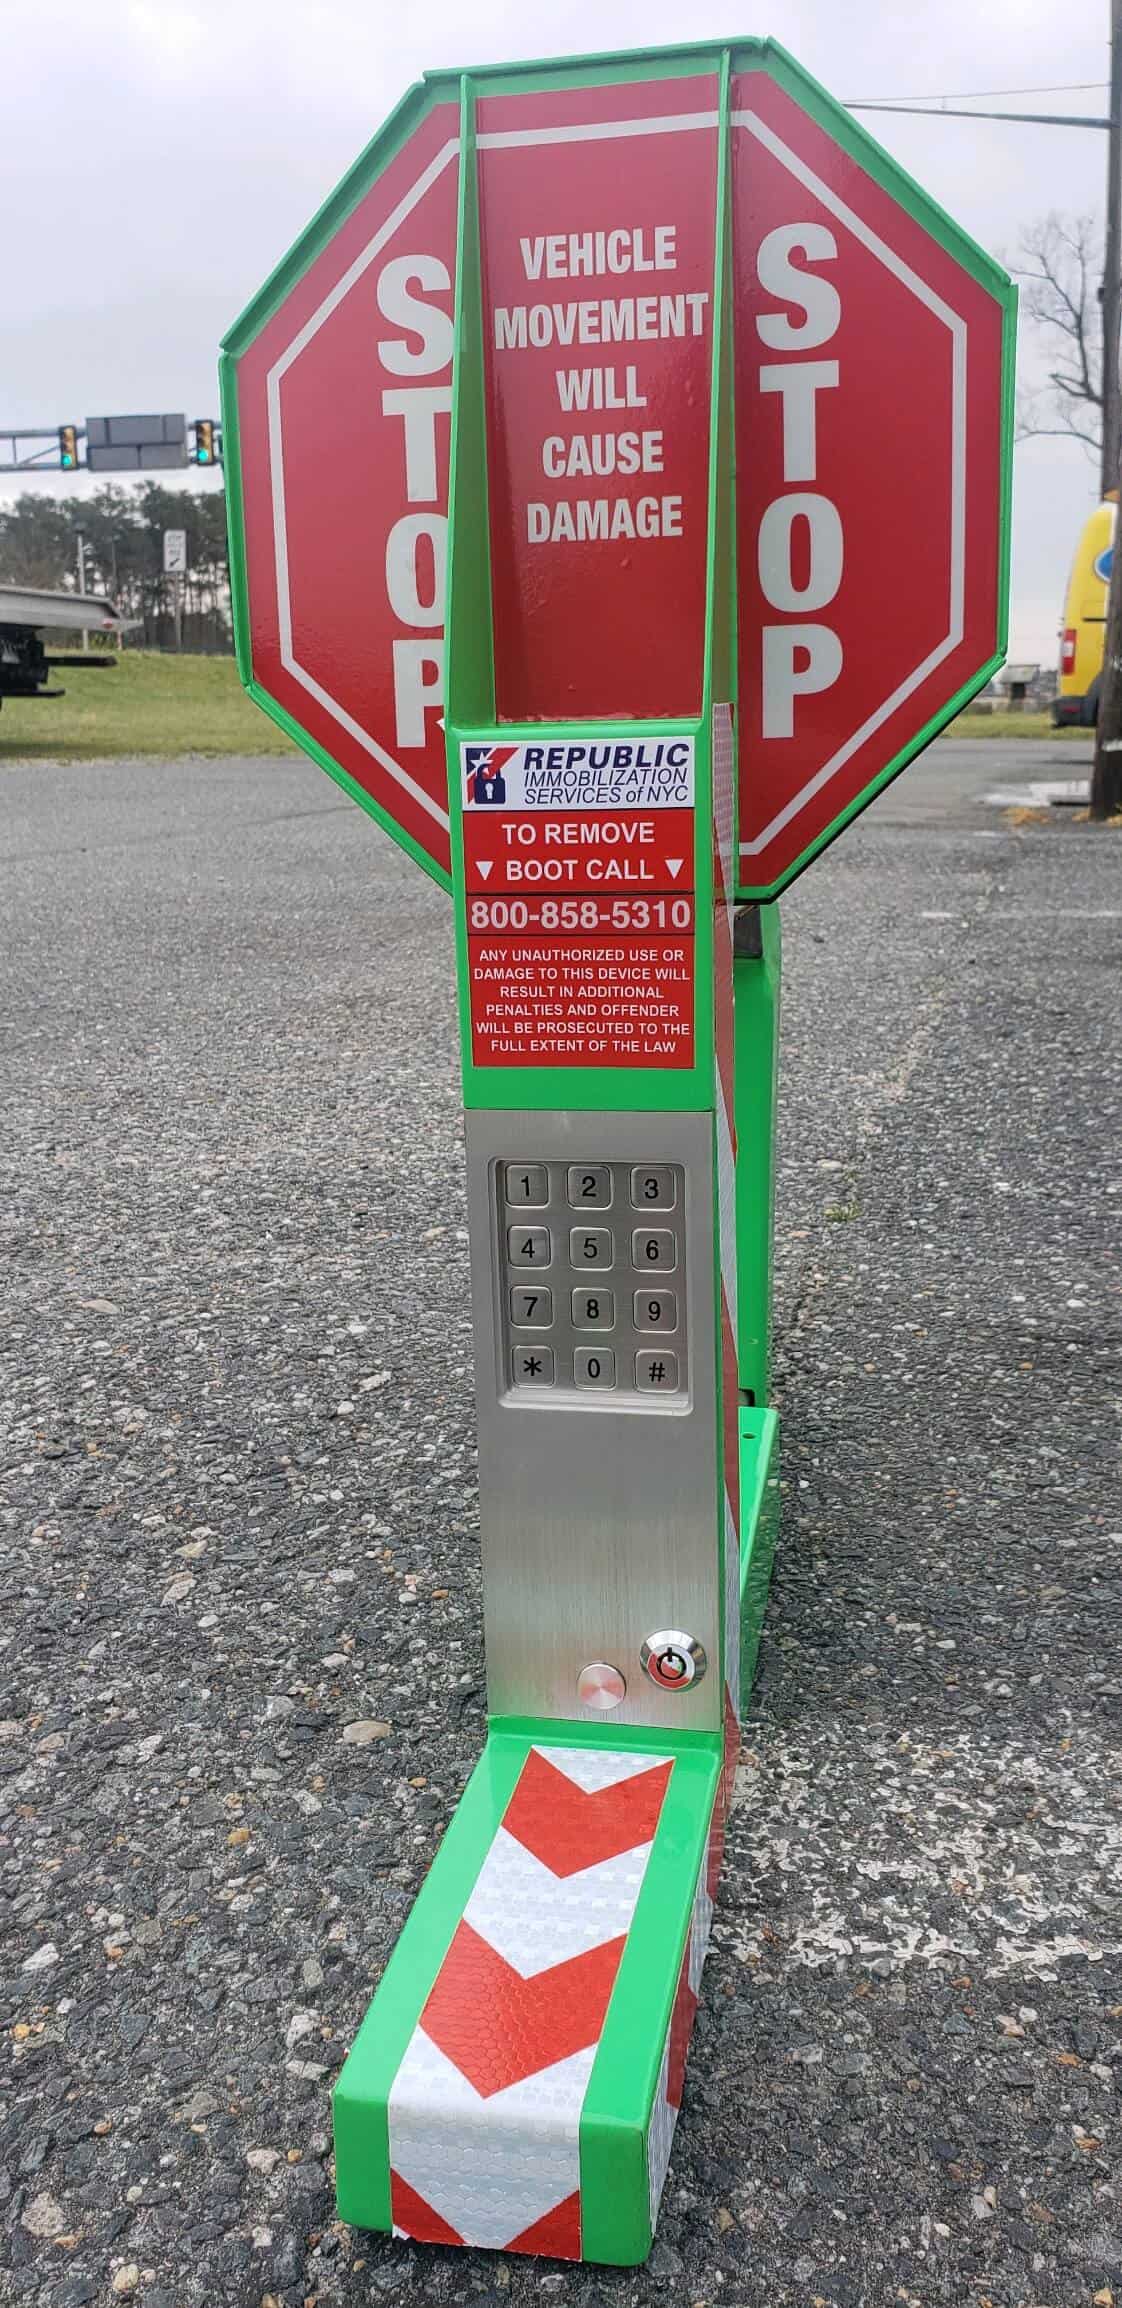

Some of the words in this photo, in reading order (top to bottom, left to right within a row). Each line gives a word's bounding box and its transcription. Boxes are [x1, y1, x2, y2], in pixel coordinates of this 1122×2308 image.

[520, 226, 677, 280] VEHICLE
[495, 293, 708, 350] MOVEMENT
[556, 365, 647, 412] WILL
[543, 430, 664, 478] CAUSE
[755, 222, 844, 739] STOP
[527, 495, 683, 543] DAMAGE
[524, 744, 689, 770] REPUBLIC
[524, 768, 687, 787] IMMOBILIZATION
[524, 788, 620, 805] SERVICES
[625, 787, 644, 802] of
[646, 785, 689, 802] NYC
[502, 824, 536, 845] TO
[545, 822, 655, 844] REMOVE
[506, 860, 578, 881] BOOT
[586, 860, 654, 880] CALL
[471, 900, 690, 929] 800-858-5310
[479, 950, 508, 961] ANY
[512, 950, 624, 961] UNAUTHORIZED
[629, 950, 658, 961] USE
[662, 950, 684, 961] OR
[474, 968, 535, 980] DAMAGE
[538, 968, 558, 980] TO
[561, 968, 594, 980] THIS
[598, 968, 651, 980] DEVICE
[655, 969, 690, 980] WILL
[500, 987, 556, 998] RESULT
[559, 987, 573, 998] IN
[577, 987, 664, 998] ADDITIONAL
[486, 1004, 563, 1016] PENALTIES
[567, 1004, 597, 1016] AND
[601, 1005, 679, 1017] OFFENDER
[476, 1022, 510, 1033] WILL
[514, 1022, 533, 1034] BE
[537, 1022, 634, 1034] PROSECUTED
[638, 1023, 658, 1035] TO
[662, 1023, 690, 1035] THE
[491, 1040, 526, 1051] FULL
[530, 1040, 584, 1052] EXTENT
[588, 1040, 608, 1052] OF
[612, 1041, 640, 1052] THE
[644, 1041, 676, 1052] LAW
[521, 1176, 530, 1196] 1
[582, 1176, 596, 1197] 2
[644, 1179, 658, 1199] 3
[521, 1239, 535, 1258] 4
[584, 1238, 597, 1258] 5
[646, 1240, 659, 1260] 6
[524, 1297, 538, 1316] 7
[586, 1299, 599, 1319] 8
[649, 1301, 661, 1321] 9
[588, 1358, 600, 1378] 0
[649, 1362, 665, 1381] #
